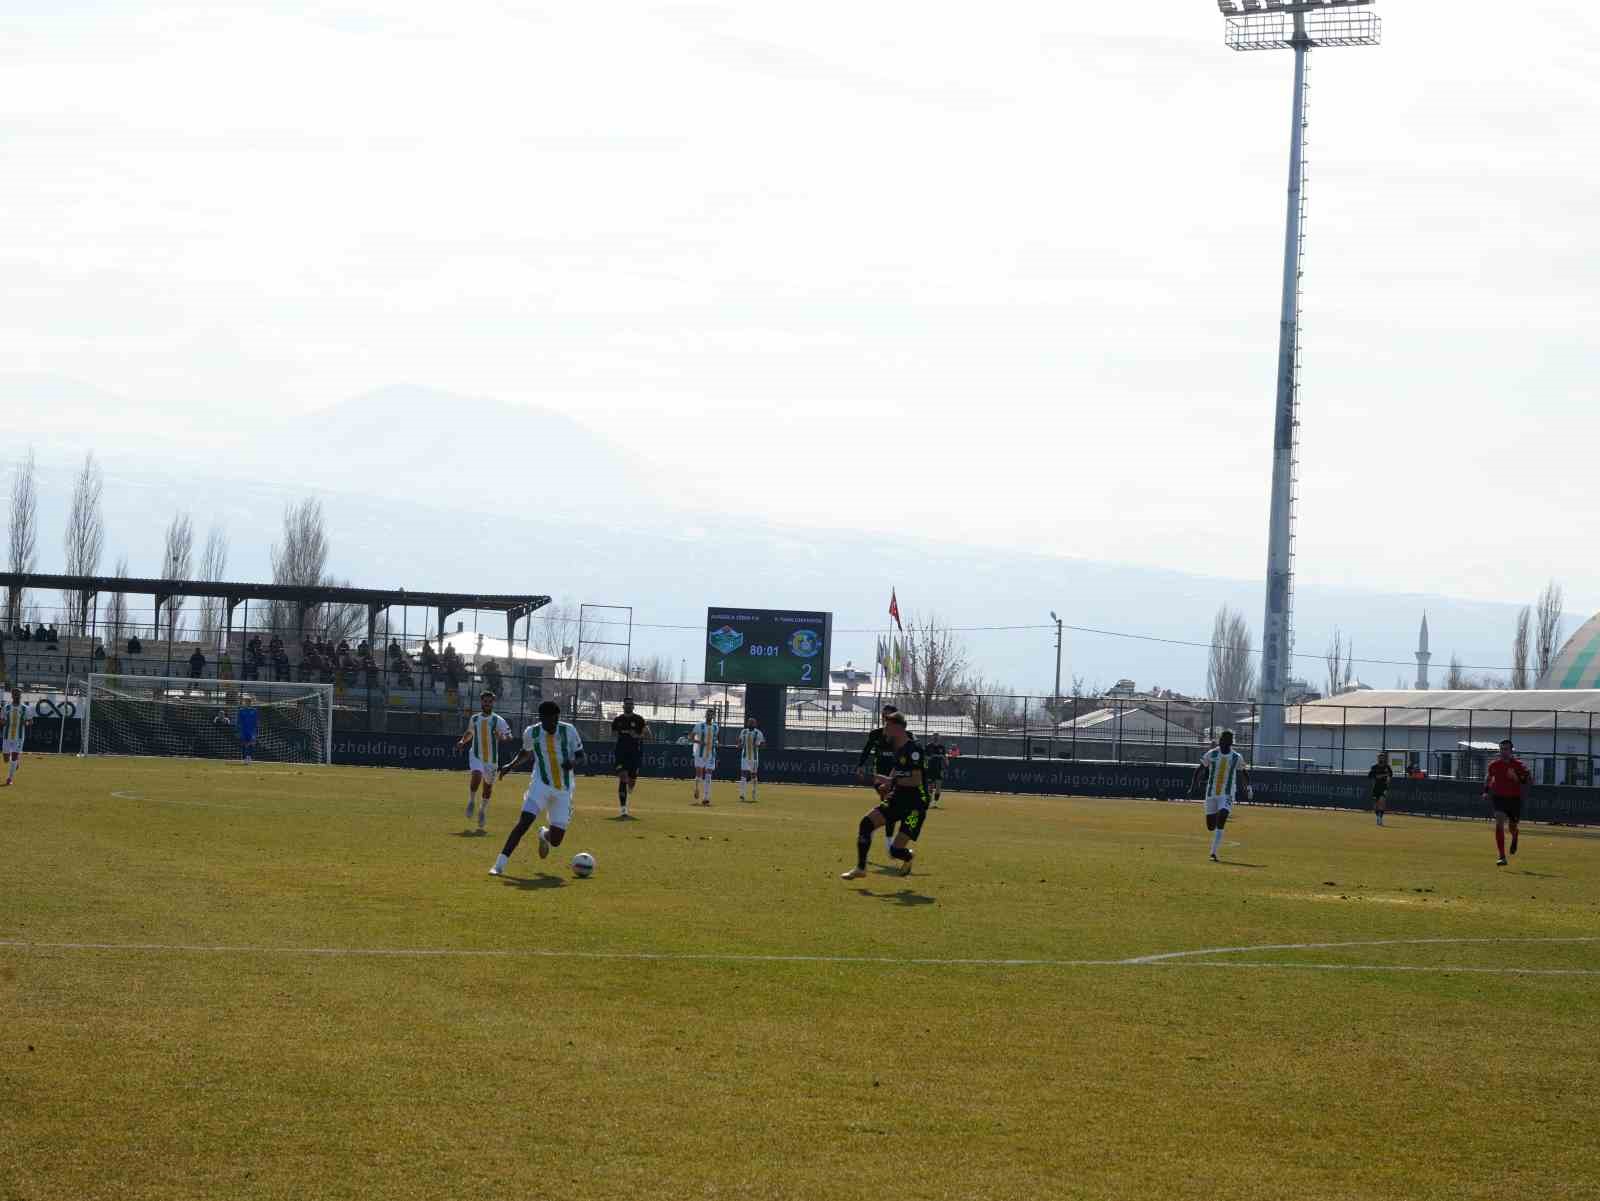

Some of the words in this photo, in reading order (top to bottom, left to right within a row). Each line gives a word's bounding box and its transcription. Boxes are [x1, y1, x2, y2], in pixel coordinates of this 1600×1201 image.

[750, 645, 779, 656] 80:01
[718, 660, 725, 677] 1
[801, 664, 812, 680] 2
